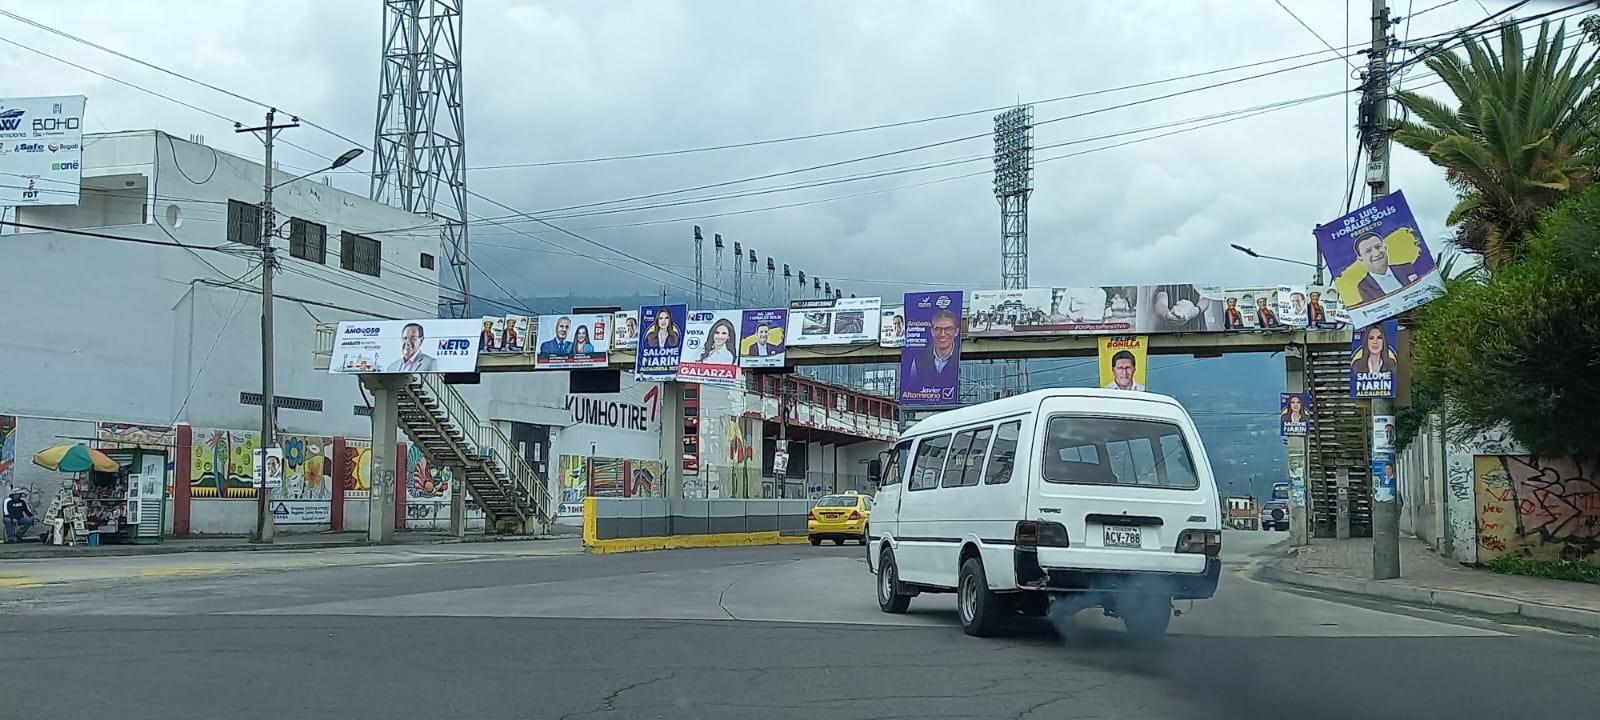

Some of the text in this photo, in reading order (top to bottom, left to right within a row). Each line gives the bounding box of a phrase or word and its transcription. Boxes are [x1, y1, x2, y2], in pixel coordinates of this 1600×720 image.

[32, 117, 79, 131] BOHO
[1359, 206, 1378, 220] LUIS
[1371, 205, 1397, 224] SOLÍS
[1350, 220, 1372, 238] PREFECTO
[687, 312, 714, 321] RETO
[438, 339, 470, 350] RETO
[680, 367, 733, 377] GALARZA
[1356, 380, 1392, 391] MARÍN
[902, 391, 941, 399] Altamirano
[1106, 533, 1140, 544] ACV-788
